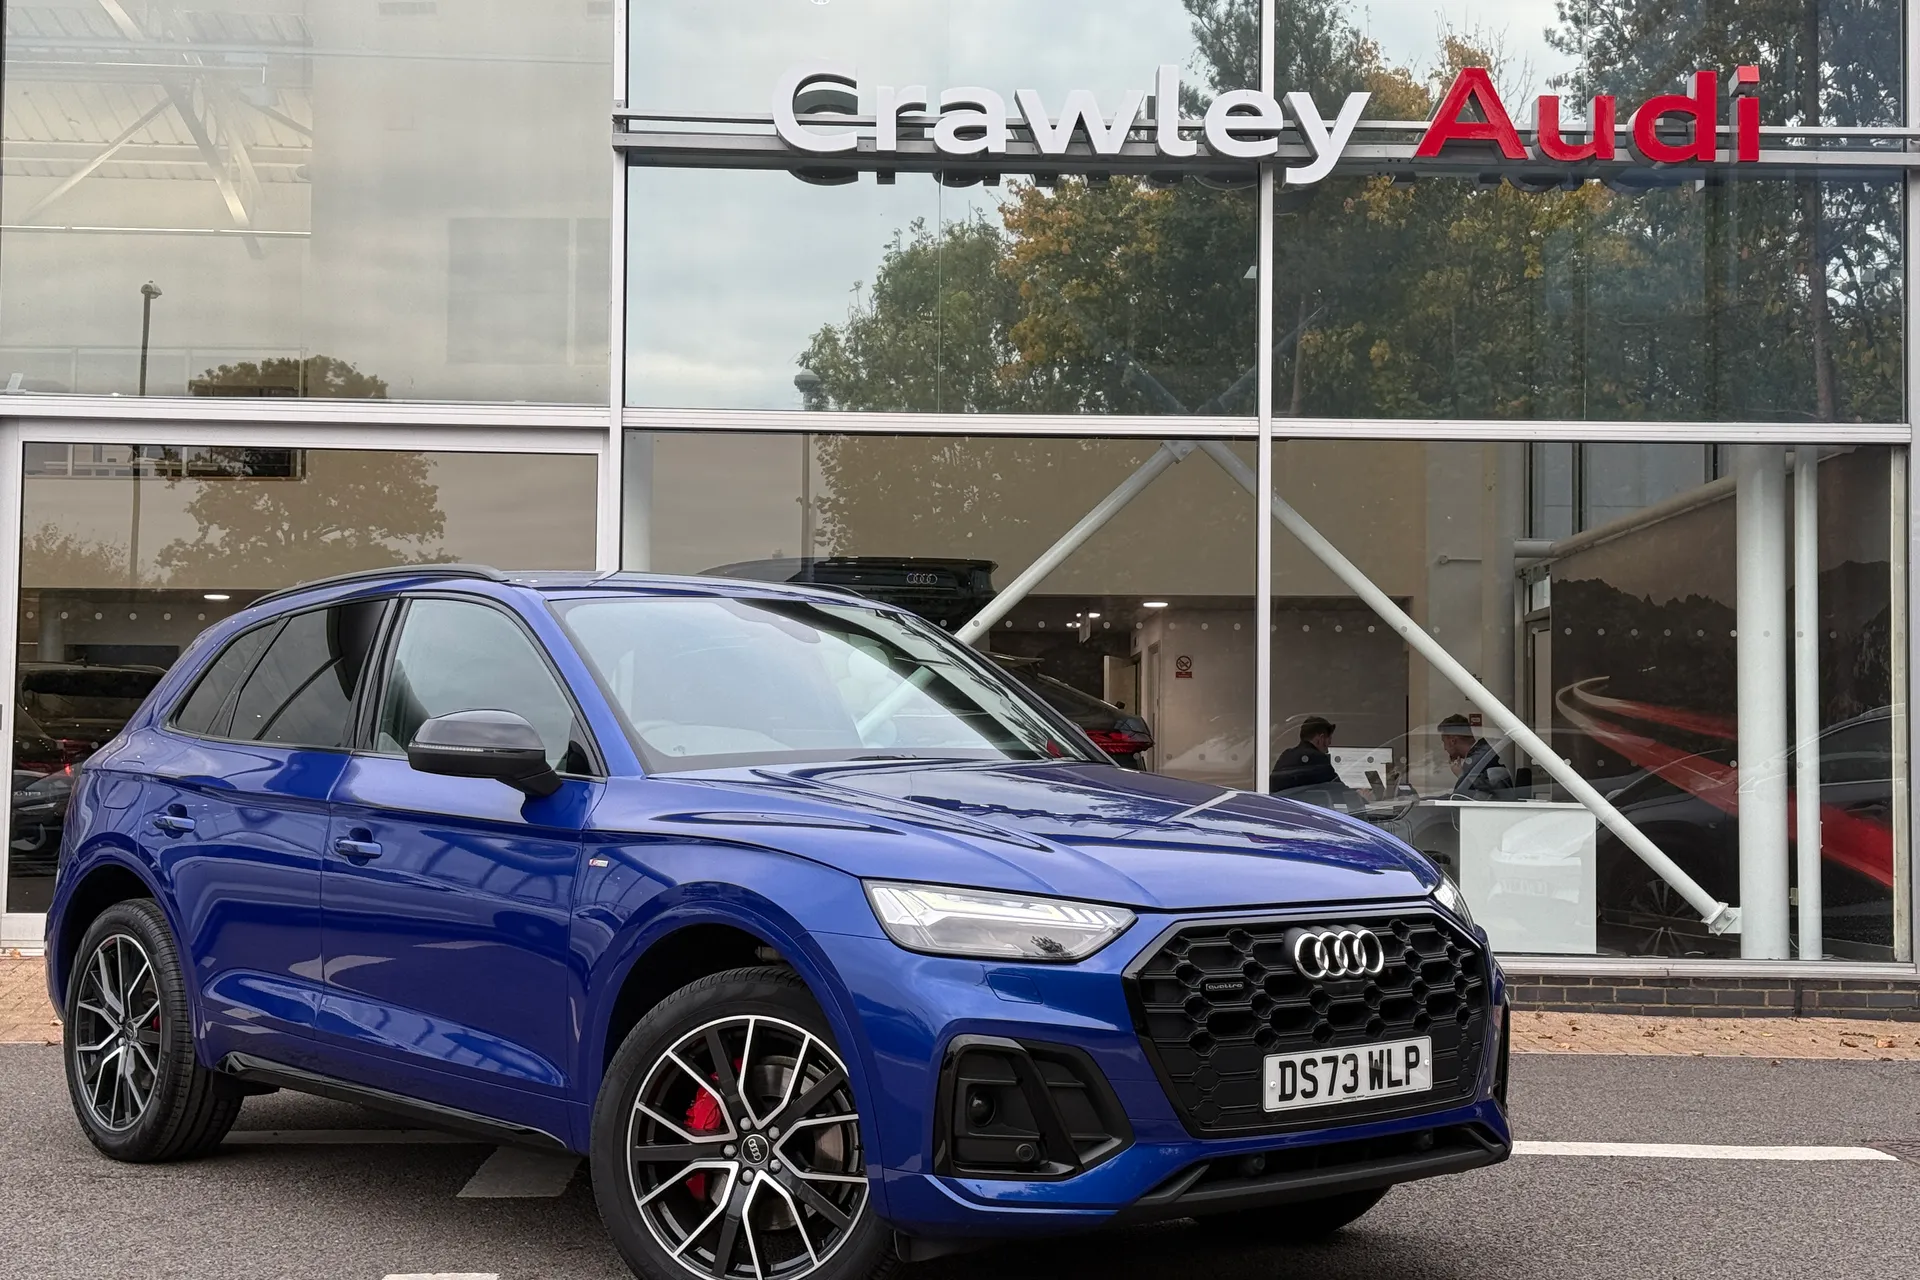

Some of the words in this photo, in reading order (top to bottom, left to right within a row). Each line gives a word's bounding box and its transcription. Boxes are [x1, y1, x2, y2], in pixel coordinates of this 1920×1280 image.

[772, 64, 1371, 186] Crawley
[1411, 65, 1760, 164] Audi
[1278, 1053, 1359, 1102] DS73
[1368, 1045, 1420, 1091] WLP
